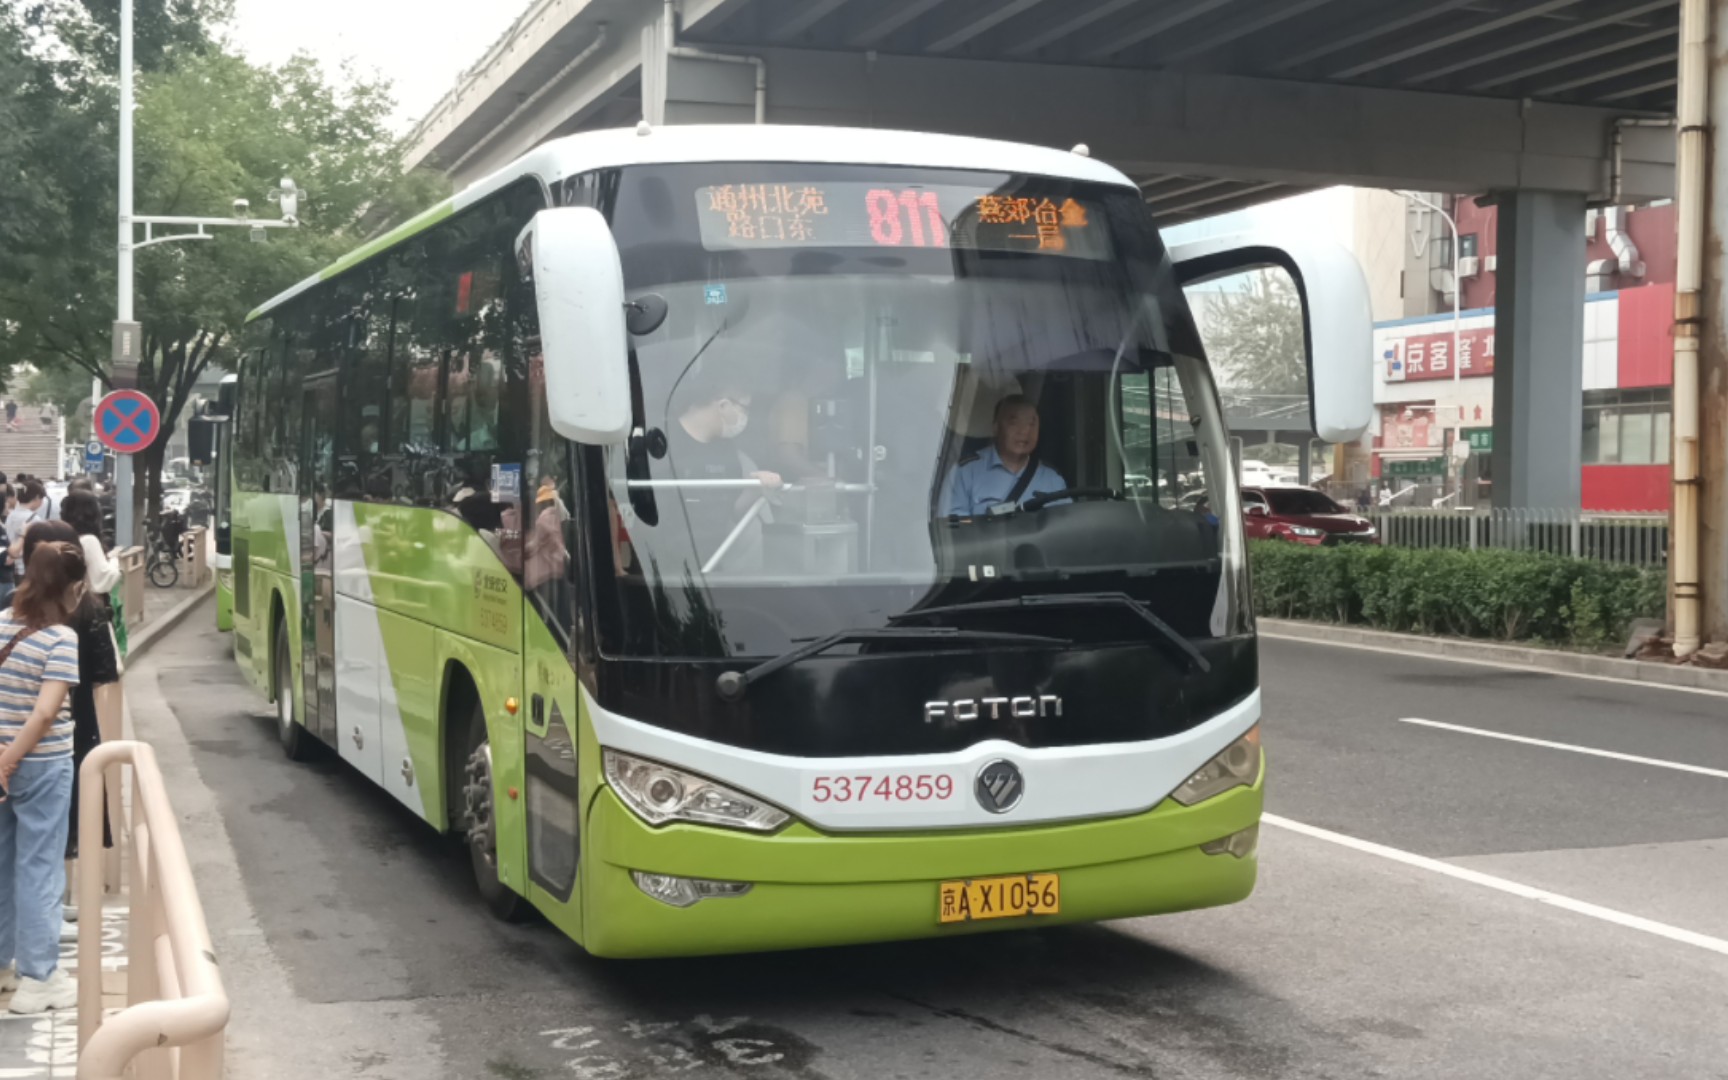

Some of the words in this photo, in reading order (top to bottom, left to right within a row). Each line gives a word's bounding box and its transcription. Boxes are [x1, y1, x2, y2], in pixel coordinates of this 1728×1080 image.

[706, 184, 829, 215] 通州北苑
[727, 209, 816, 240] 路口东
[864, 188, 945, 248] 811
[925, 695, 1063, 723] FOTON
[812, 774, 954, 803] 5374859
